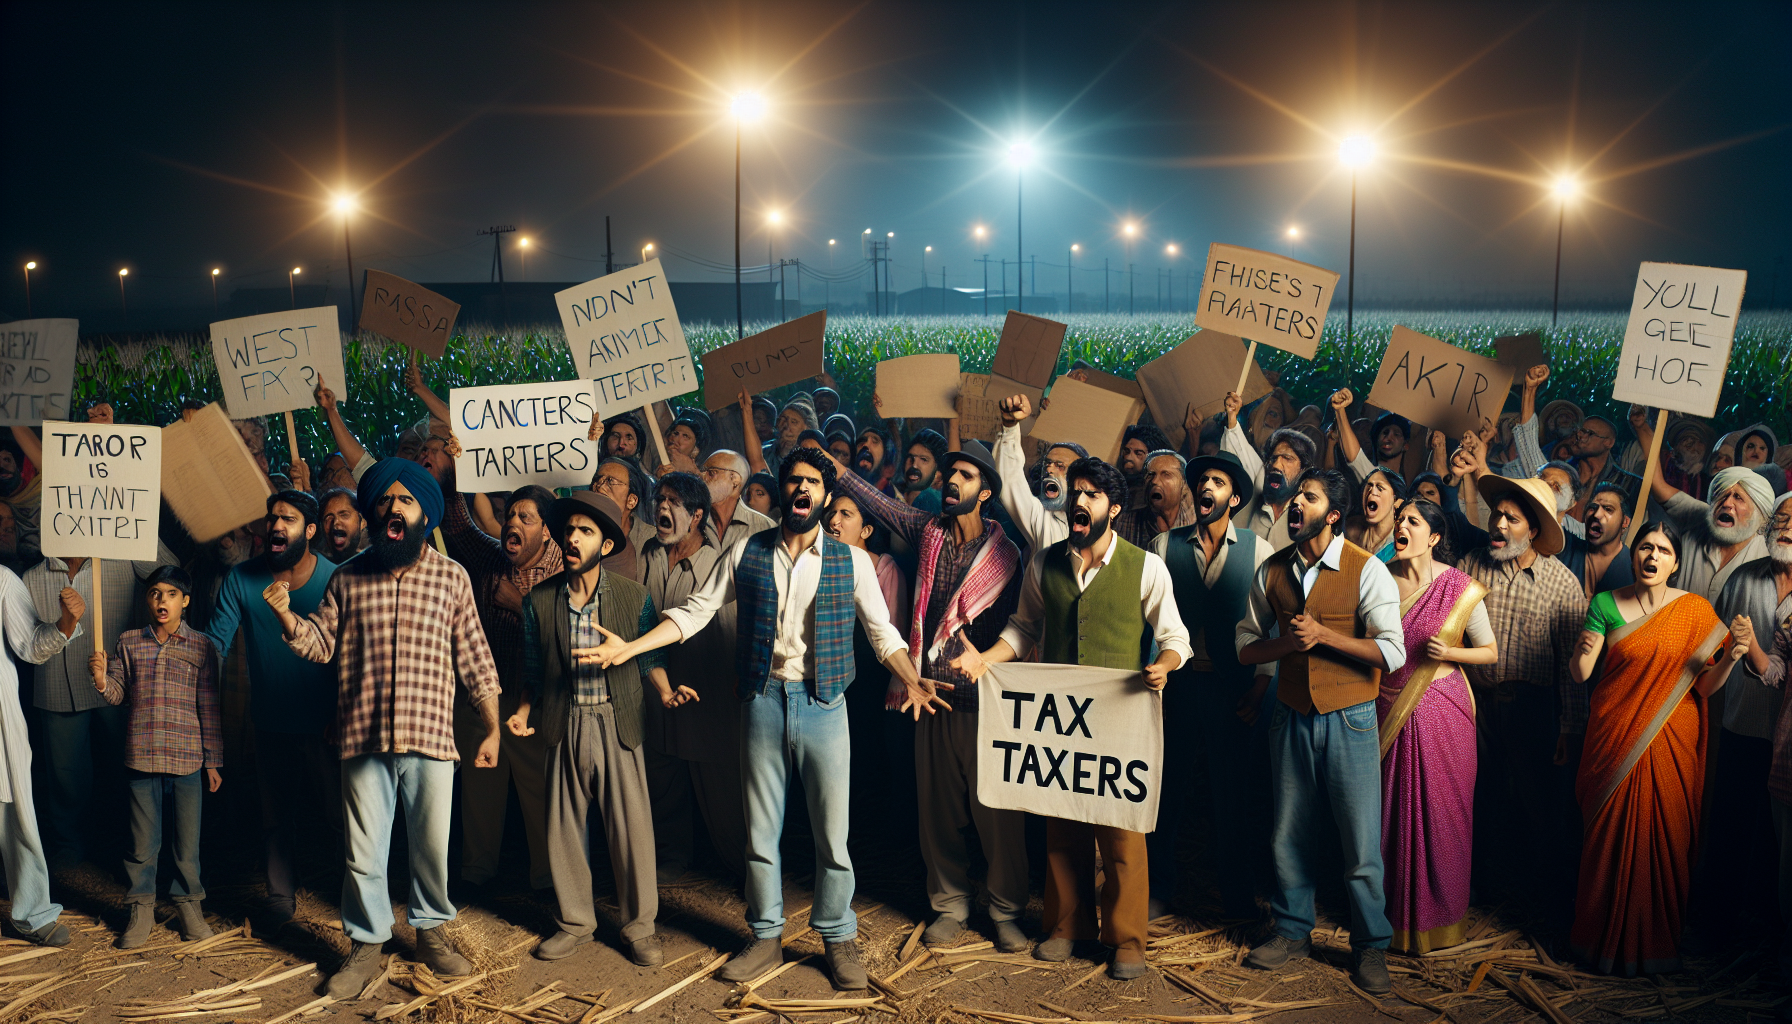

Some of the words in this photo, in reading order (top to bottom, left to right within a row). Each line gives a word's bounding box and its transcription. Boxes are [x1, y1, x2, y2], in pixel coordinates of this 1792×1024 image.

[224, 325, 317, 369] WEST
[462, 392, 594, 431] CANCTERS
[51, 433, 147, 461] TAROR
[465, 437, 589, 478] TARTERS
[1001, 689, 1095, 739] TAX
[992, 739, 1149, 803] TAXERS
